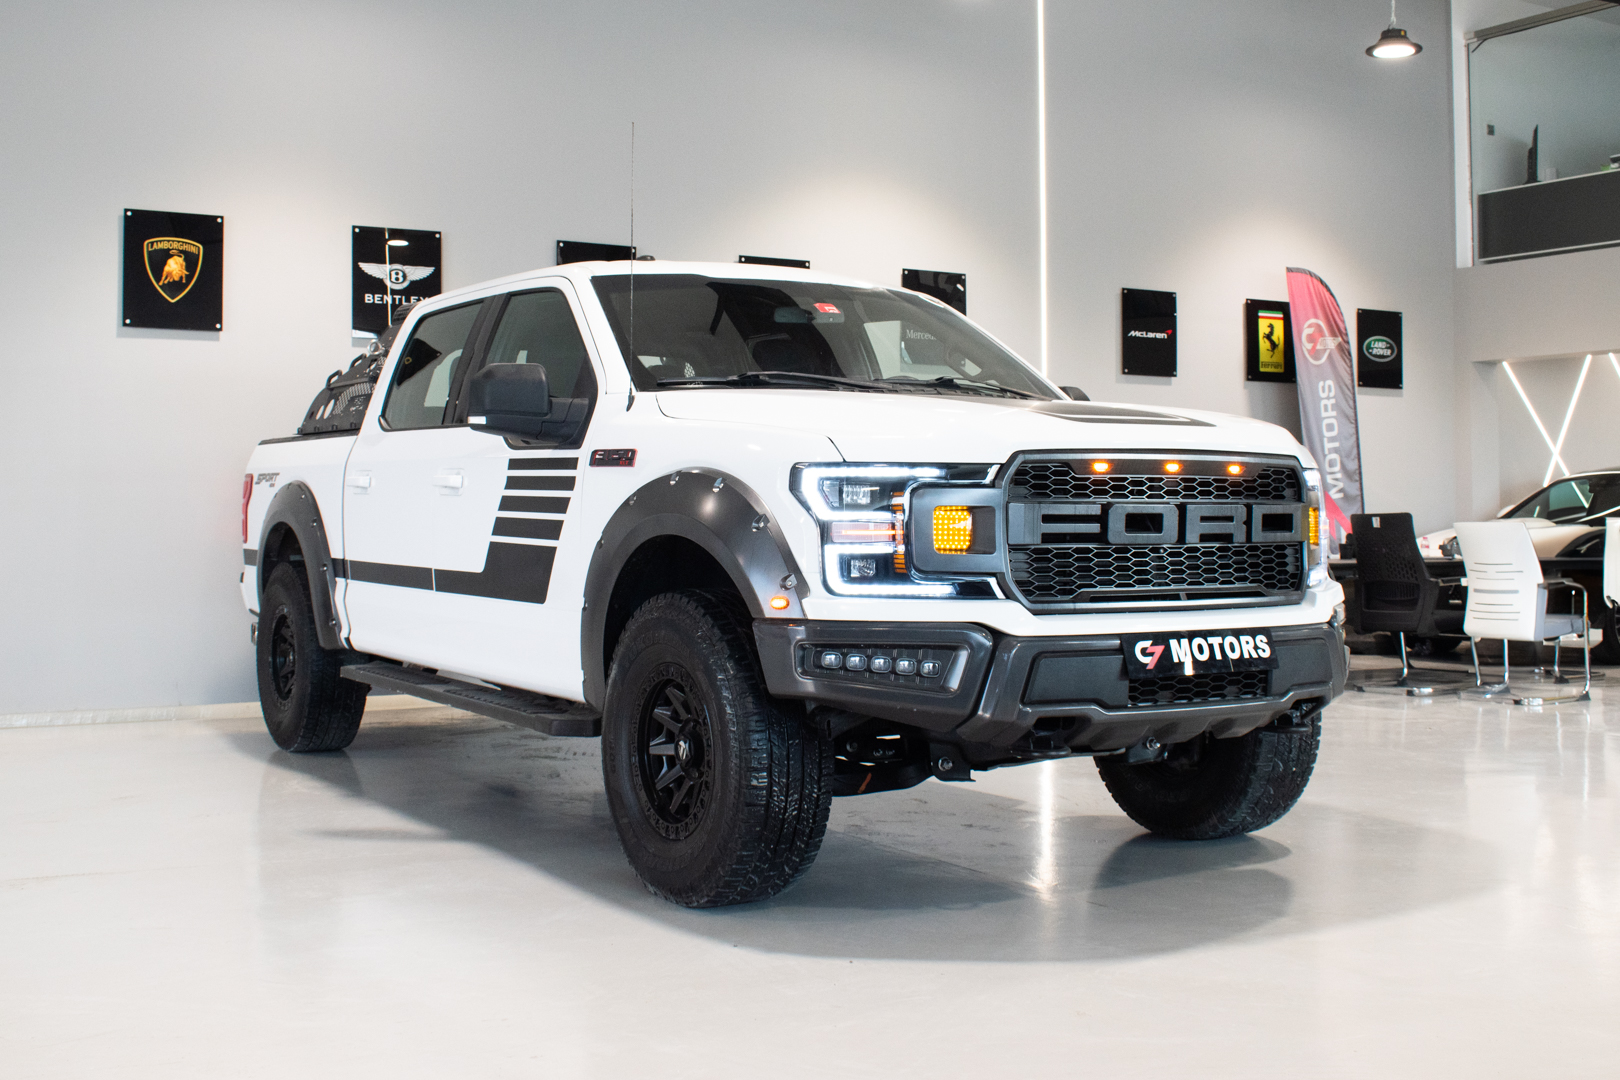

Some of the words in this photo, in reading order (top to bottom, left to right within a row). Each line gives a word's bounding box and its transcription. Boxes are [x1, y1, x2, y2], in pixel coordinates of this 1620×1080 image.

[148, 241, 198, 255] LAMBORGHINI
[1128, 330, 1168, 339] McLaren
[1318, 379, 1345, 500] MOTORS
[1008, 503, 1303, 545] FORD
[1168, 634, 1272, 664] MOTORS
